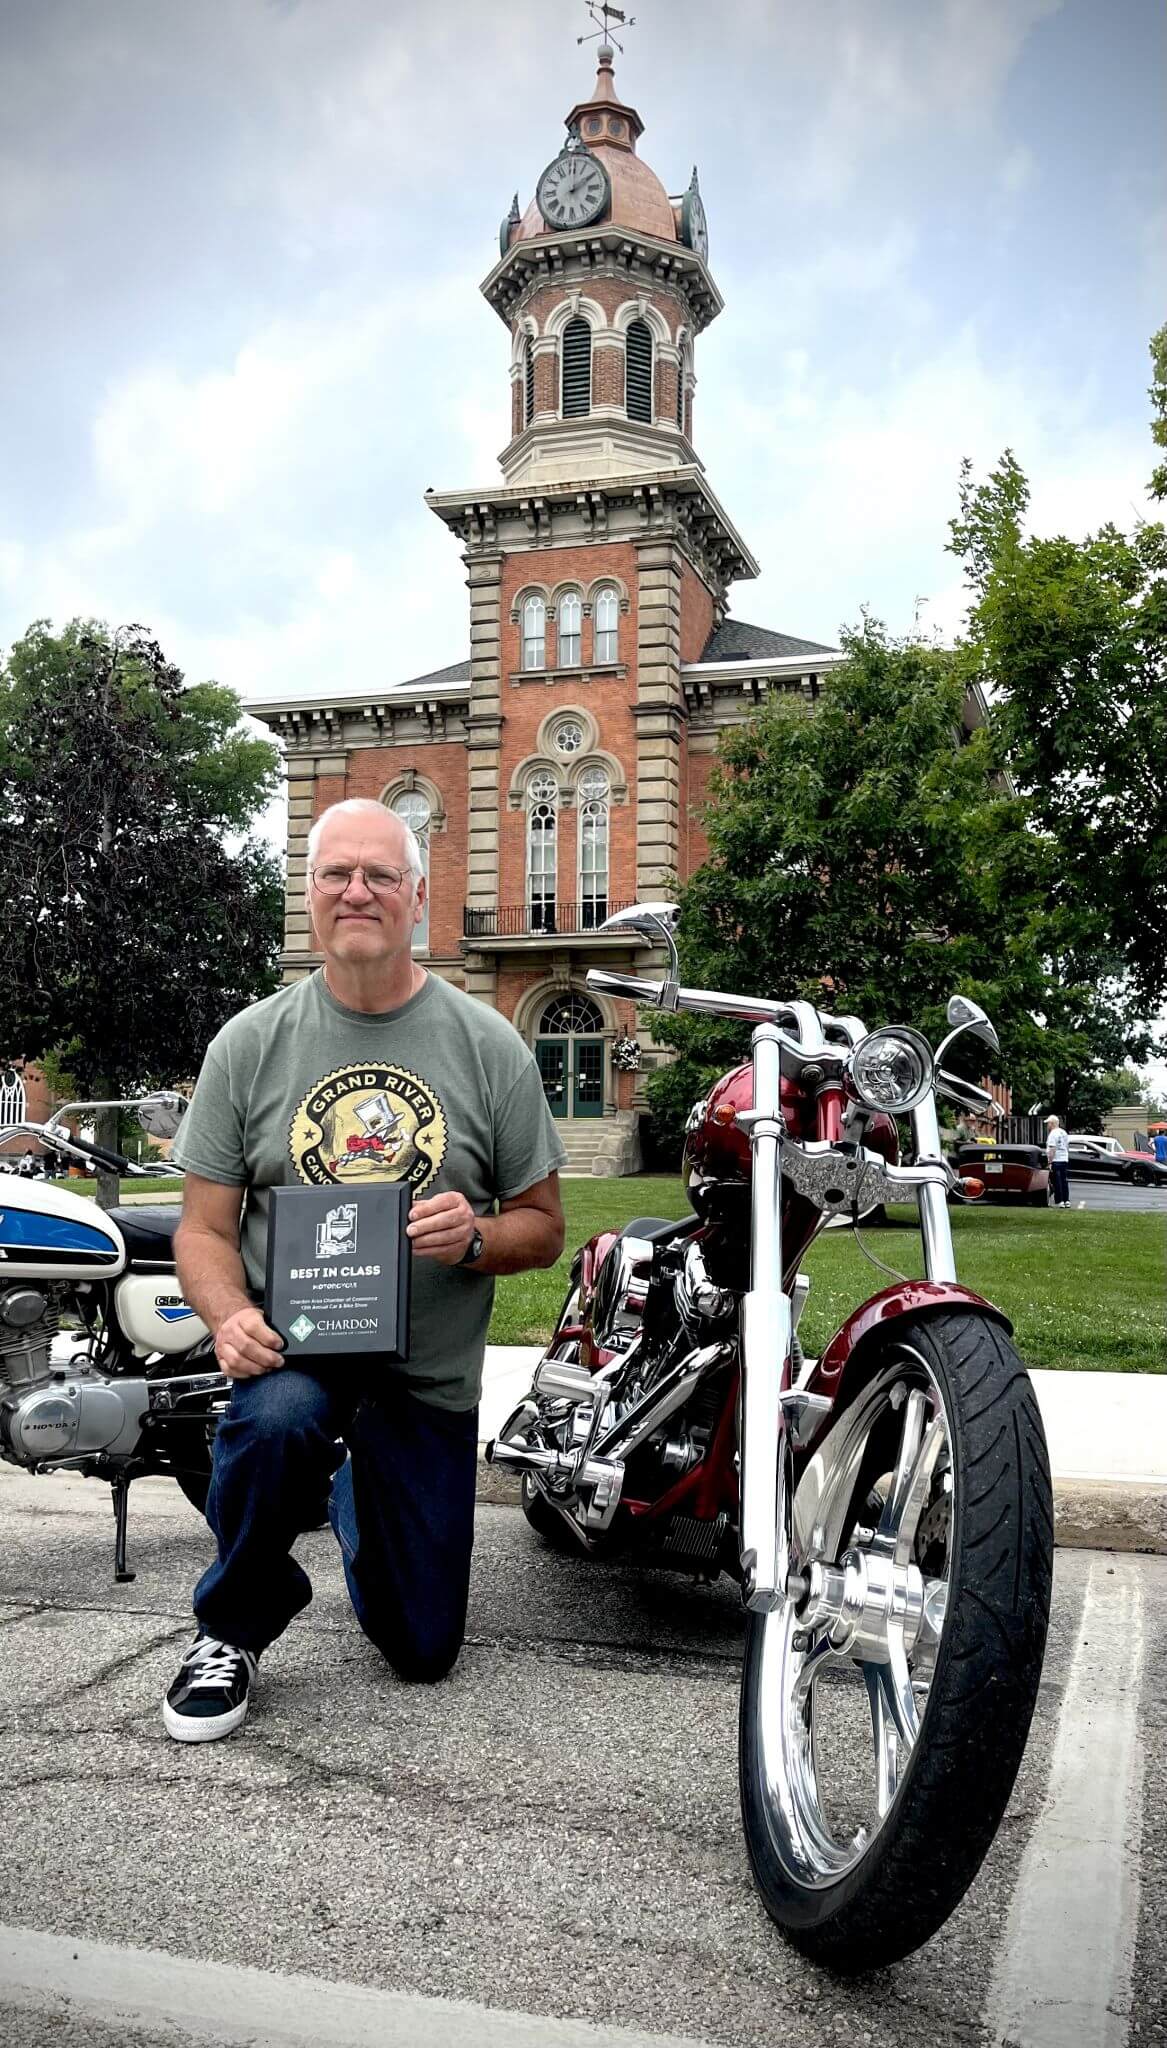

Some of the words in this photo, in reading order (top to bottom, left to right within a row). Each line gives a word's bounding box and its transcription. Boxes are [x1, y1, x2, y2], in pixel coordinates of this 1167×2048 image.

[312, 1073, 377, 1113] GRAND
[384, 1075, 433, 1121] RIVER
[305, 1154, 333, 1186] CANO
[407, 1159, 429, 1183] ACE
[290, 1268, 320, 1280] BEST
[322, 1267, 338, 1278] IN
[340, 1265, 381, 1276] CLASS
[316, 1318, 378, 1330] CHARDON
